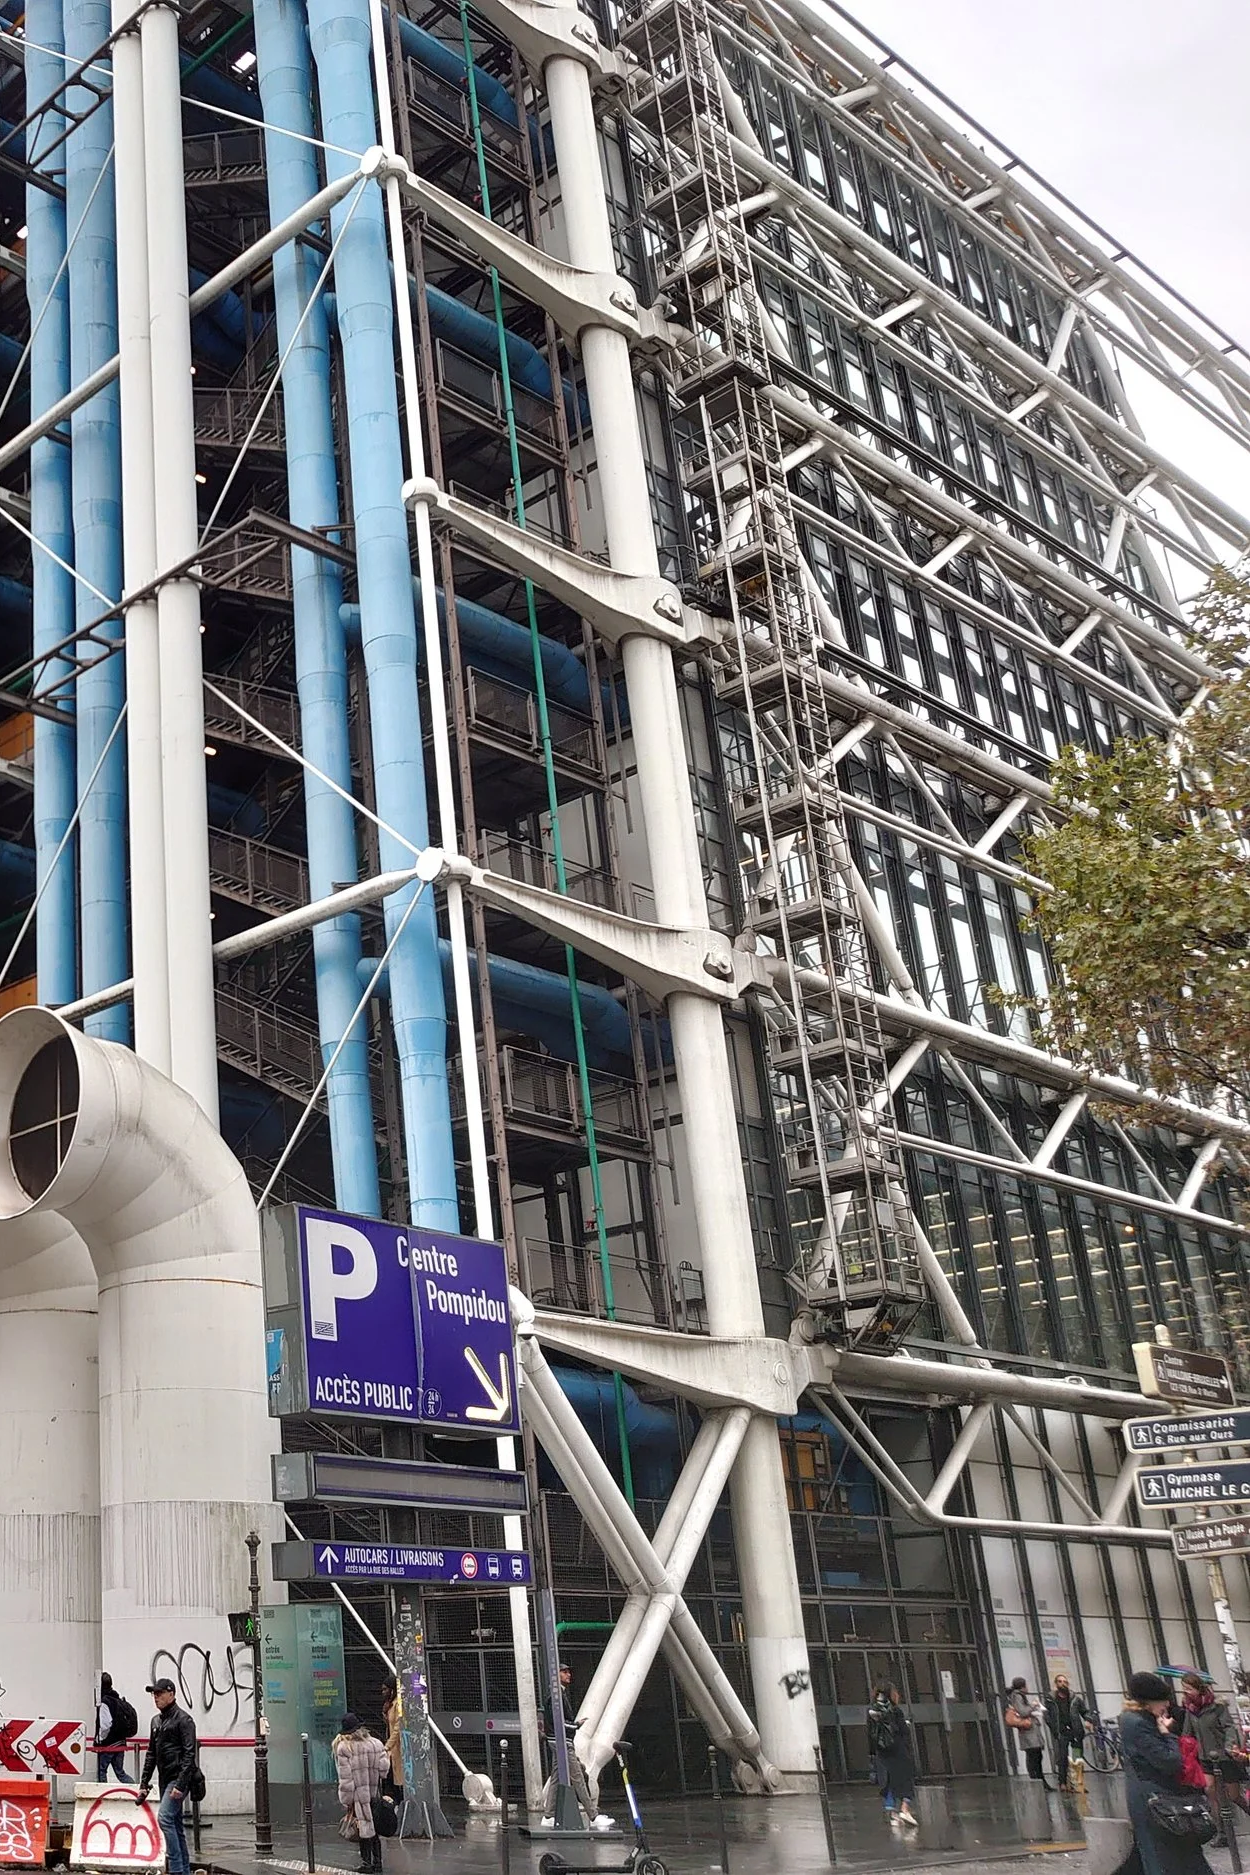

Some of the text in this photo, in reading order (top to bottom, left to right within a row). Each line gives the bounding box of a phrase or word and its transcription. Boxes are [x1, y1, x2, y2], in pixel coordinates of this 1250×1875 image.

[396, 1235, 459, 1277] Centre
[305, 1217, 378, 1342] P
[425, 1280, 507, 1325] Pompidou
[315, 1373, 413, 1411] ACCÈS PUBLIC
[1152, 1417, 1236, 1434] Commissariat
[1167, 1434, 1186, 1444] Rue
[1189, 1433, 1207, 1442] aux
[1210, 1431, 1235, 1440] Ours
[1167, 1472, 1222, 1486] Gymnase
[1170, 1485, 1218, 1499] MICHEL
[1222, 1483, 1237, 1496] LE
[344, 1547, 388, 1564] AUTOCARS
[395, 1549, 445, 1567] LIVRAISONS
[358, 1566, 366, 1574] PAR
[367, 1566, 373, 1574] LA
[373, 1566, 381, 1574] RUE
[381, 1566, 390, 1575] DES
